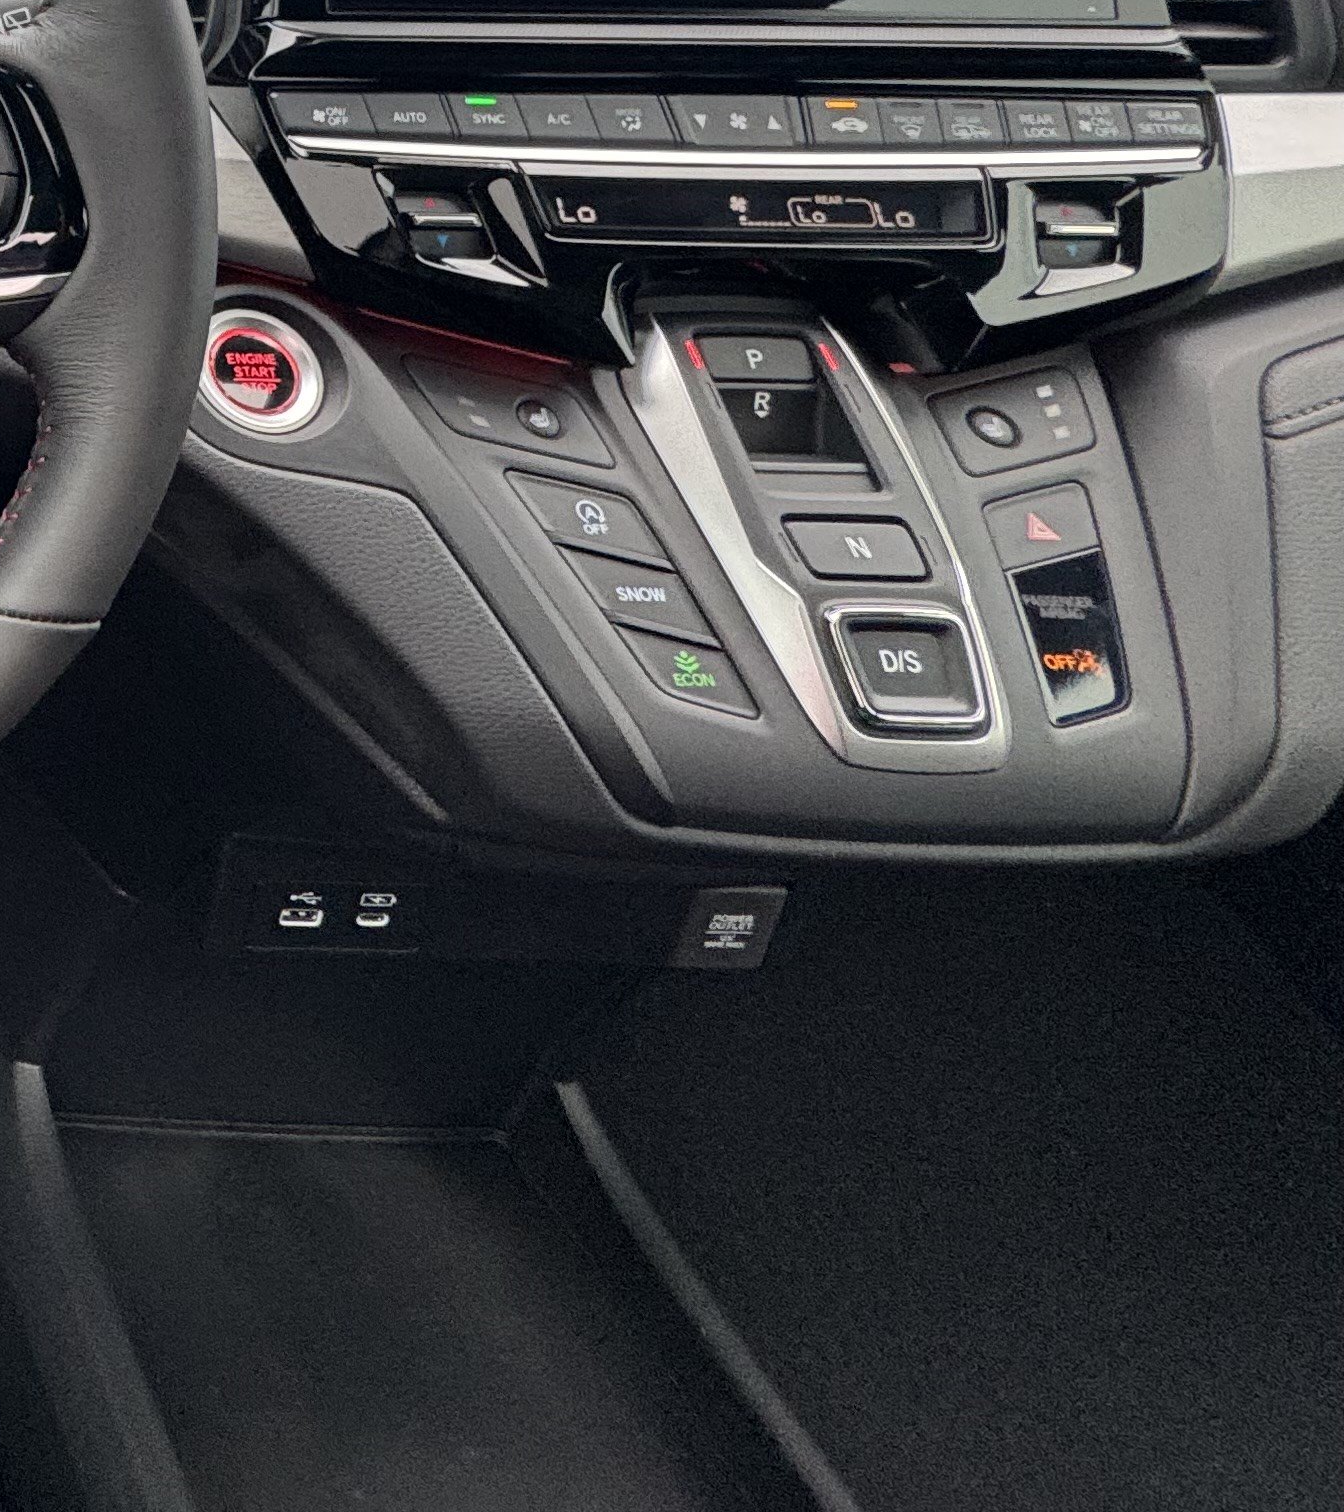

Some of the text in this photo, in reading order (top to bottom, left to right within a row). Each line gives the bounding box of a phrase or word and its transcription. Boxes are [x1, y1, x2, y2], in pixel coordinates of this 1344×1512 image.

[393, 111, 427, 123] AUTO
[472, 112, 506, 125] SYNC
[547, 112, 572, 126] A/C
[1023, 126, 1058, 139] LOCK
[557, 197, 598, 224] Lo
[796, 204, 828, 224] Lo
[873, 201, 916, 229] Lo
[225, 352, 277, 365] ENGINE
[745, 348, 764, 370] P
[234, 366, 277, 379] START
[241, 382, 278, 395] STOP
[753, 392, 771, 412] R
[583, 523, 608, 536] OFF
[844, 535, 873, 559] N
[616, 585, 666, 603] SNOW
[878, 648, 923, 675] D/S
[1043, 653, 1077, 671] OFF
[673, 670, 716, 688] ECON
